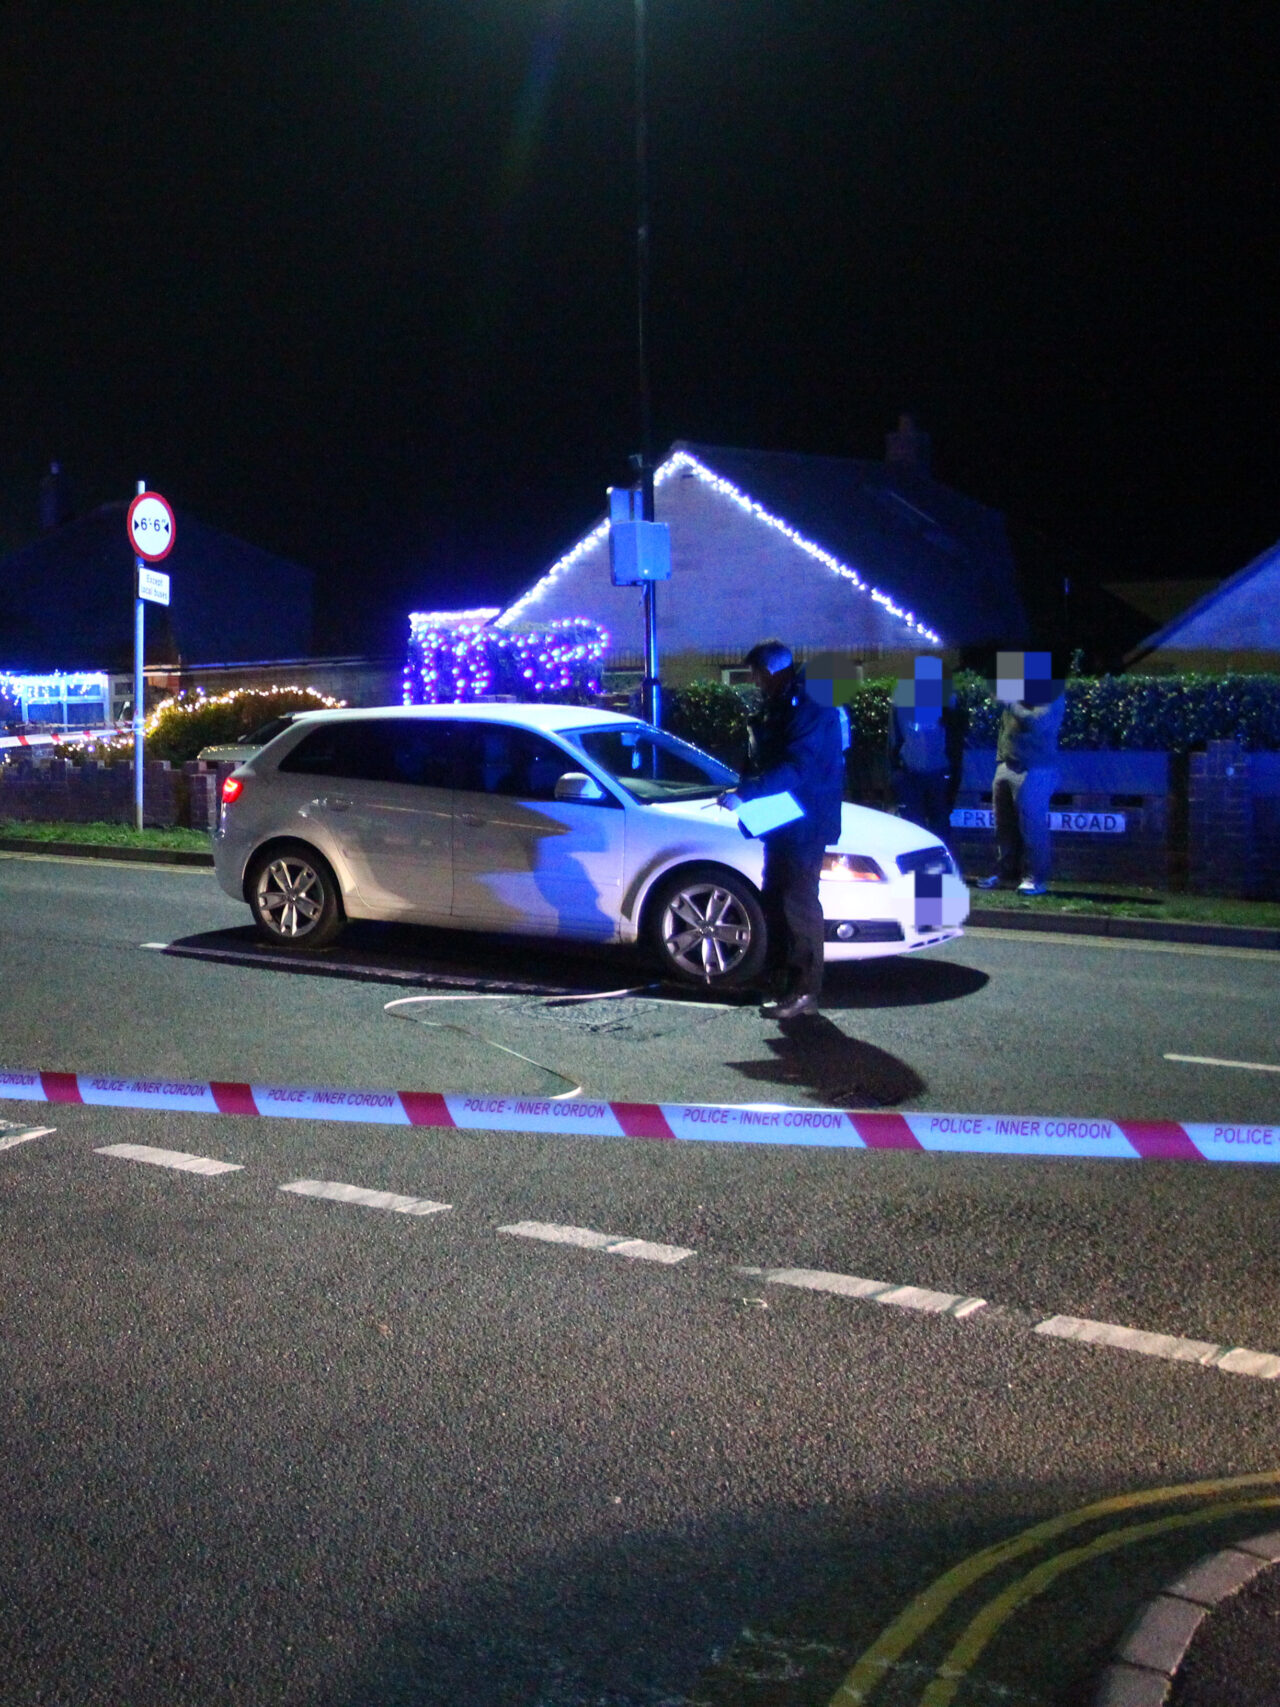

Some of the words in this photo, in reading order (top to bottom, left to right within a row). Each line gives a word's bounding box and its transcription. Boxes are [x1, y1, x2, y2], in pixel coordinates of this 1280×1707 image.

[1061, 814, 1117, 831] ROAD
[91, 1080, 123, 1092] POLICE
[131, 1081, 160, 1094] INNER
[163, 1083, 207, 1097] CORDON
[268, 1088, 304, 1103] POLICE
[312, 1091, 345, 1105] INNER
[348, 1093, 395, 1108] CORDON
[463, 1098, 504, 1114] POLICE
[515, 1100, 550, 1116] INNER
[553, 1102, 605, 1119] CORDON
[683, 1108, 728, 1124] POLICE
[740, 1110, 779, 1126] INNER
[783, 1112, 842, 1129] CORDON
[930, 1117, 983, 1134] POLICE
[995, 1120, 1040, 1137] INNER
[1044, 1121, 1112, 1140] CORDON
[1213, 1126, 1273, 1146] POLICE
